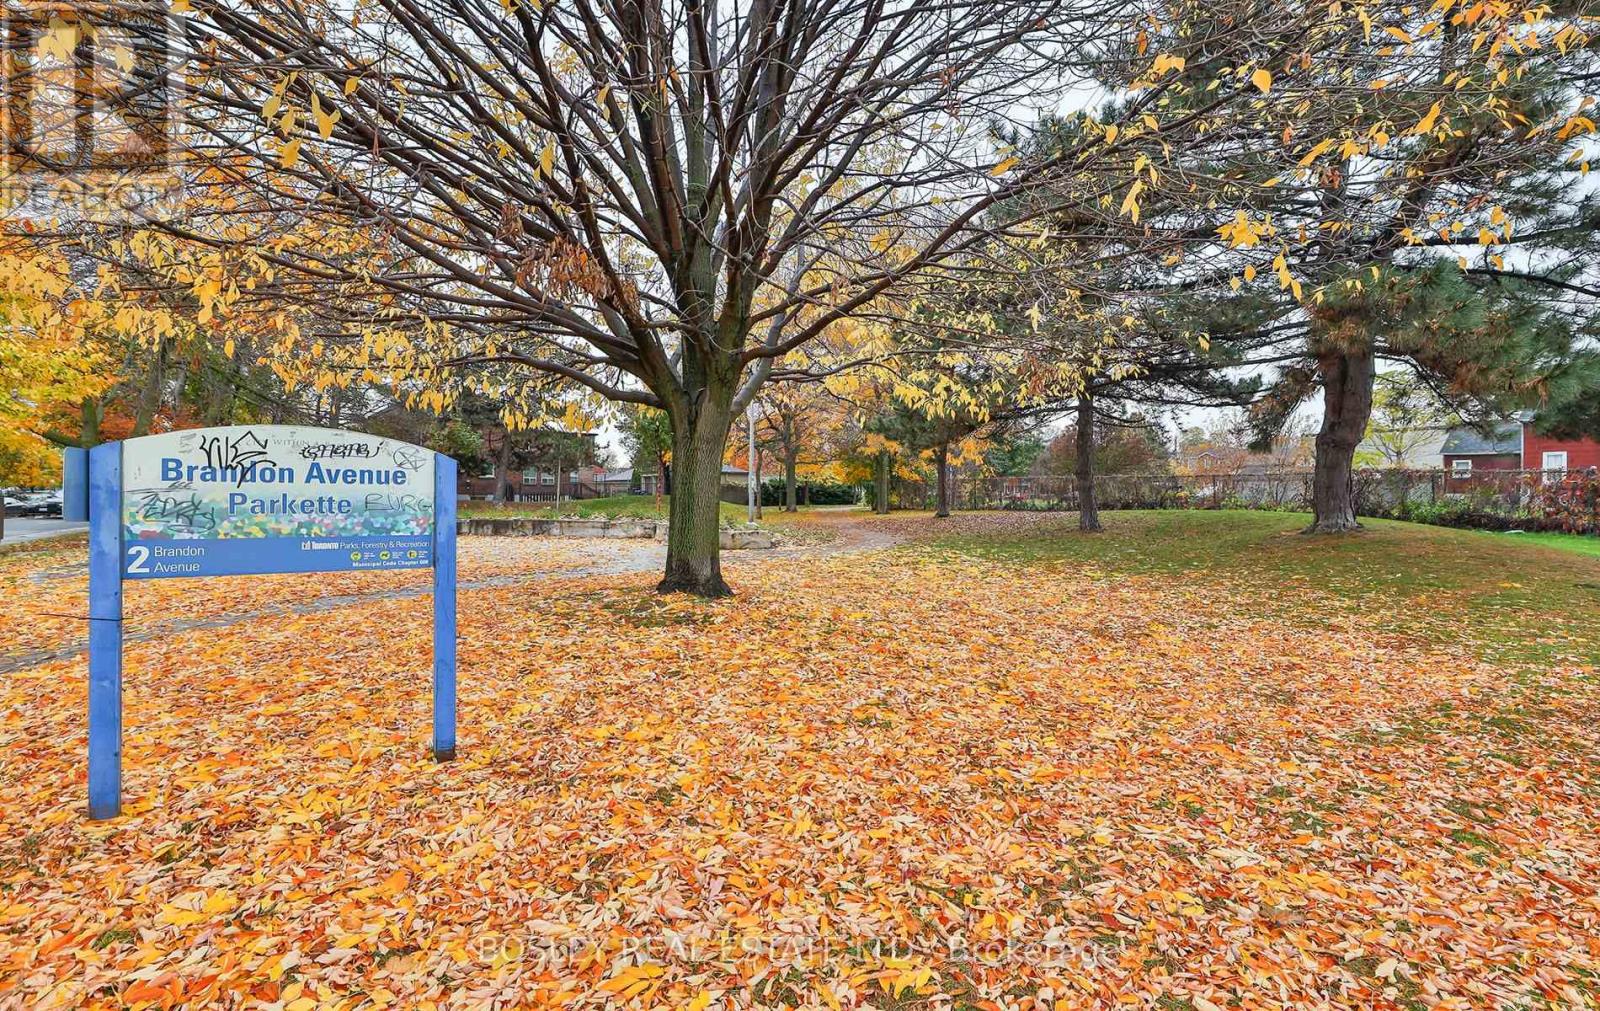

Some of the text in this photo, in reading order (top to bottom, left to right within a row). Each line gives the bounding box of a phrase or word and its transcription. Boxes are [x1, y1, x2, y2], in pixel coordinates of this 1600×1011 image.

[161, 457, 295, 485] Brandon
[304, 461, 408, 485] Avenue
[228, 492, 353, 515] Parkette
[154, 545, 205, 557] Brandon
[361, 541, 389, 550] Forestry
[396, 540, 430, 548] Recreation
[127, 545, 150, 574] 2
[153, 562, 201, 573] Avenue
